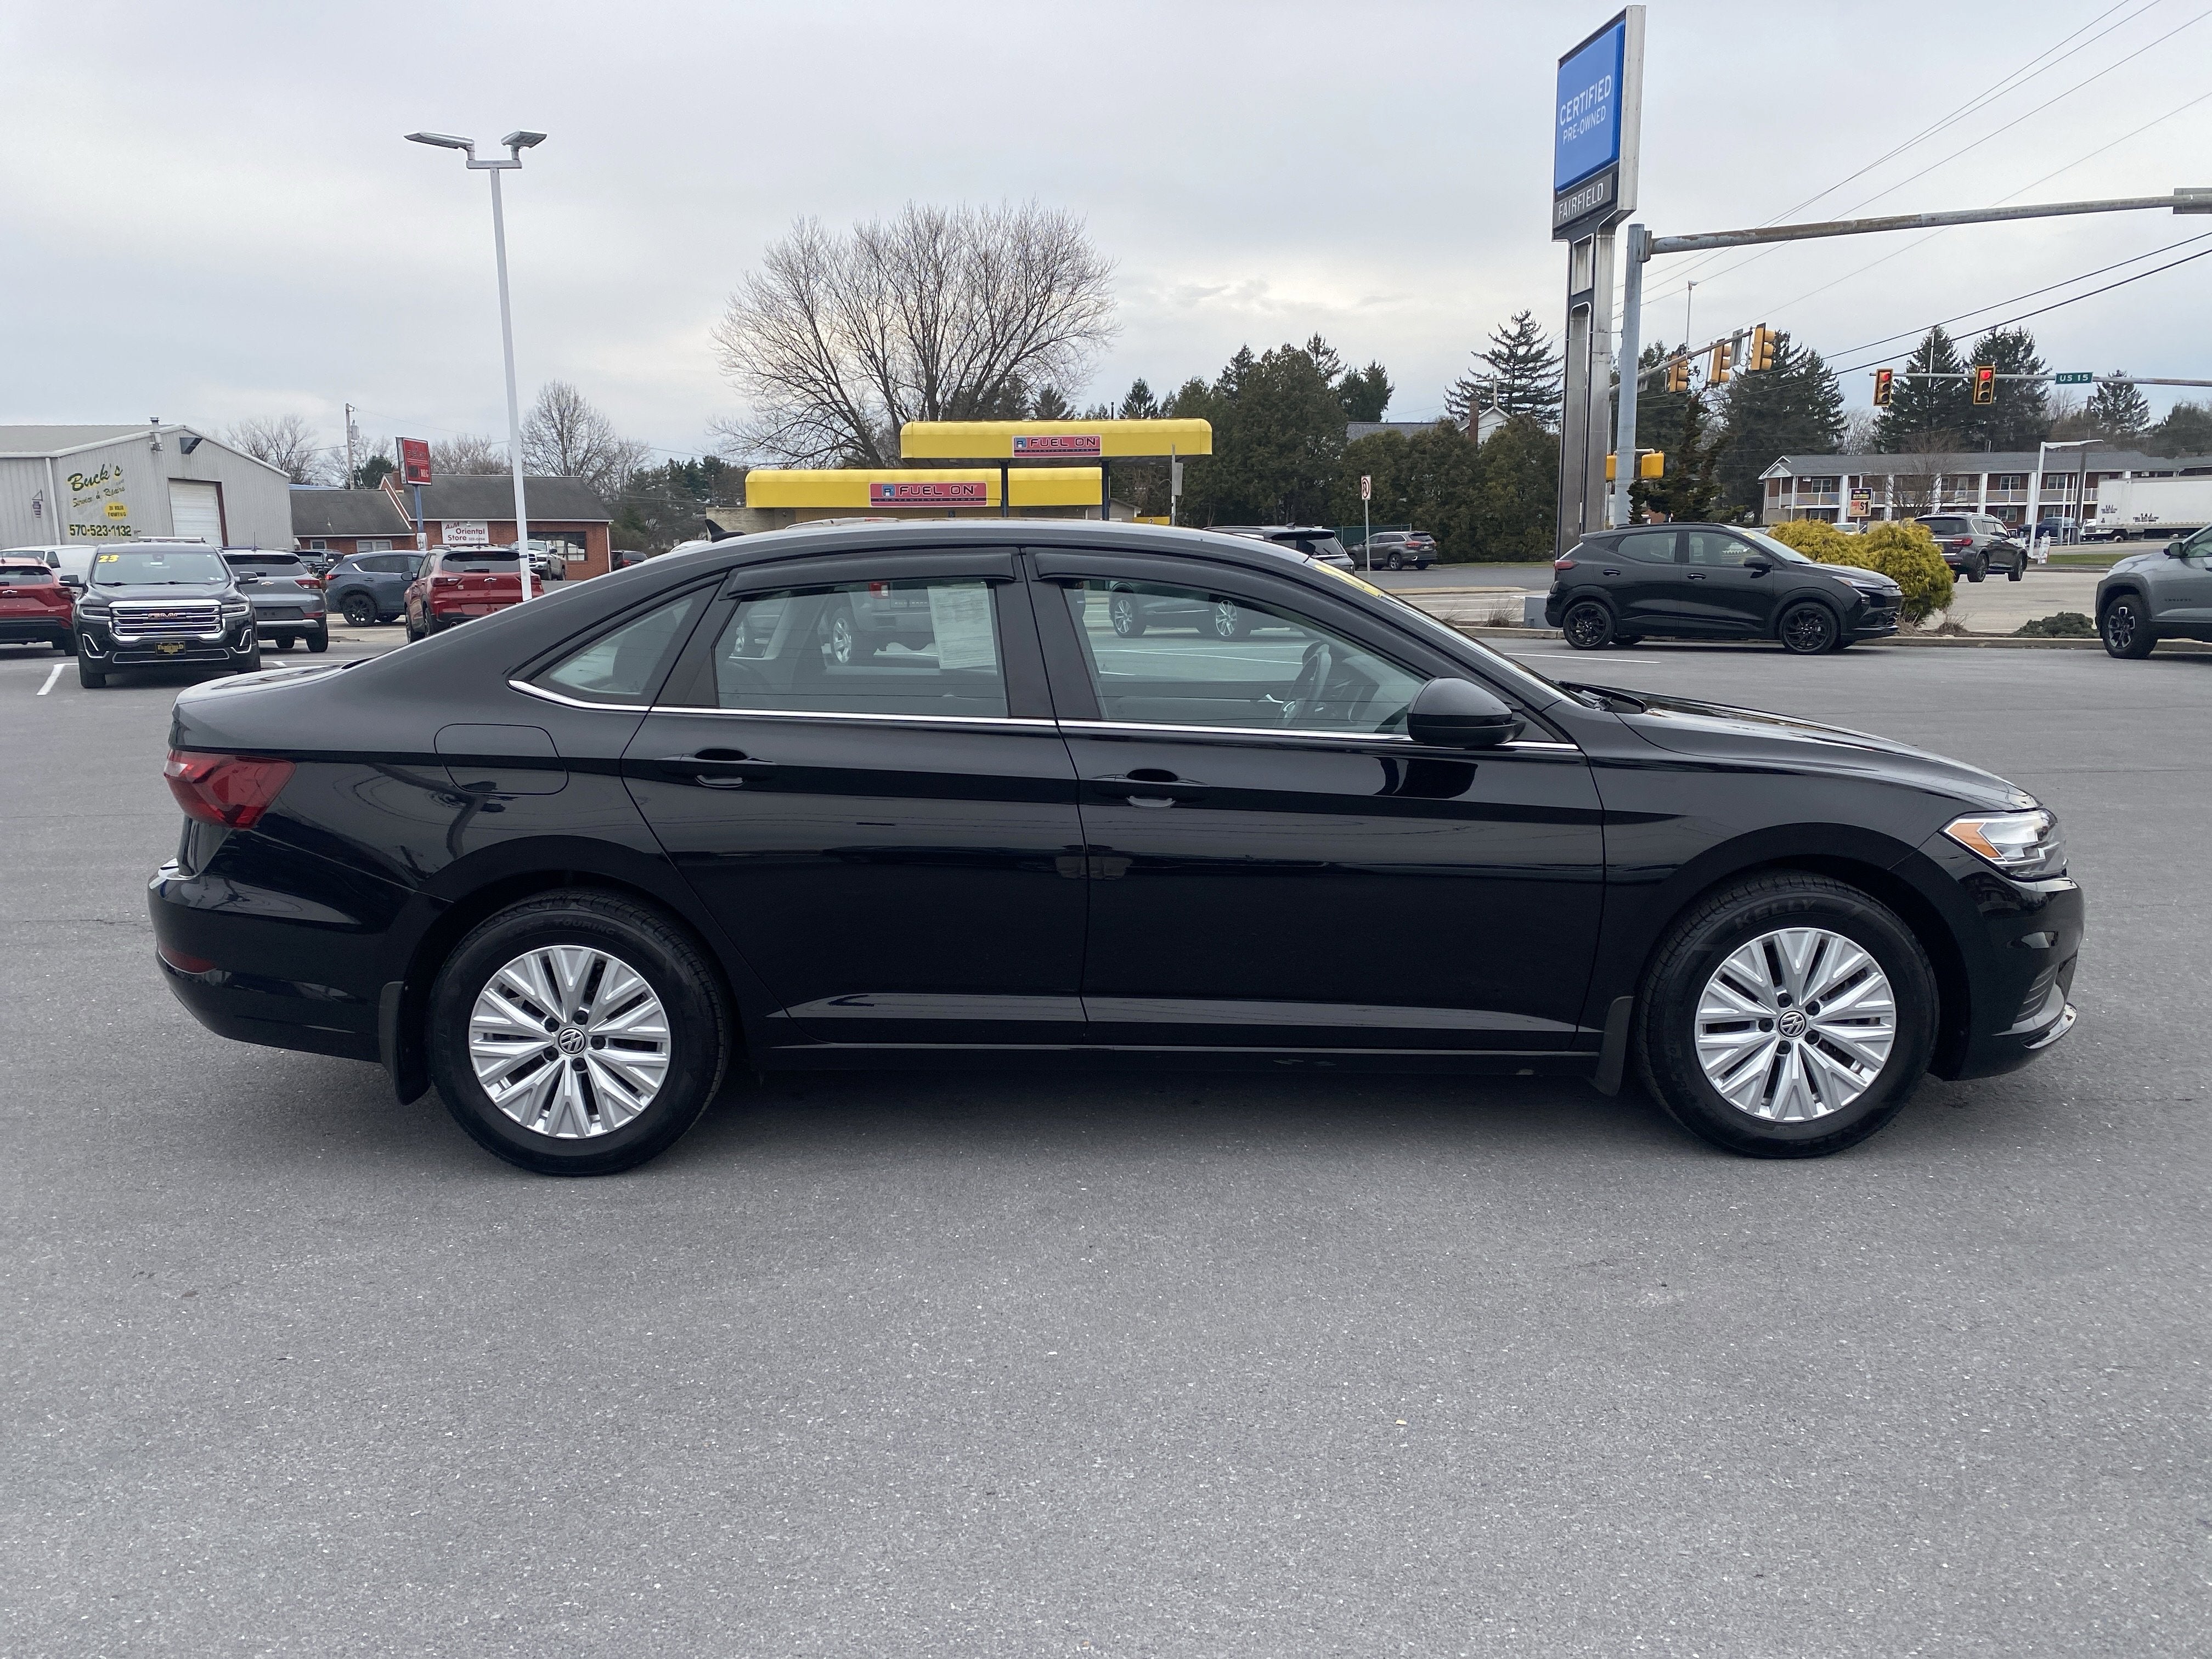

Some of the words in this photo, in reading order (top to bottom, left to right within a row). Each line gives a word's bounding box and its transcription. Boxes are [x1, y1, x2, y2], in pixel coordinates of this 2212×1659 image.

[1560, 75, 1612, 126] CERTIFIED
[1562, 105, 1606, 145] PRE-OWNED
[1559, 183, 1604, 221] FAIRFIELD
[1030, 438, 1069, 447] FUEL
[1075, 437, 1097, 447] ON
[67, 463, 123, 491] Buck's
[899, 485, 944, 495] FUEL
[950, 484, 975, 495] ON
[69, 524, 132, 537] 570-523-1132
[98, 554, 120, 563] 23
[1735, 899, 1818, 930] KELLY
[554, 918, 616, 935] TOURING
